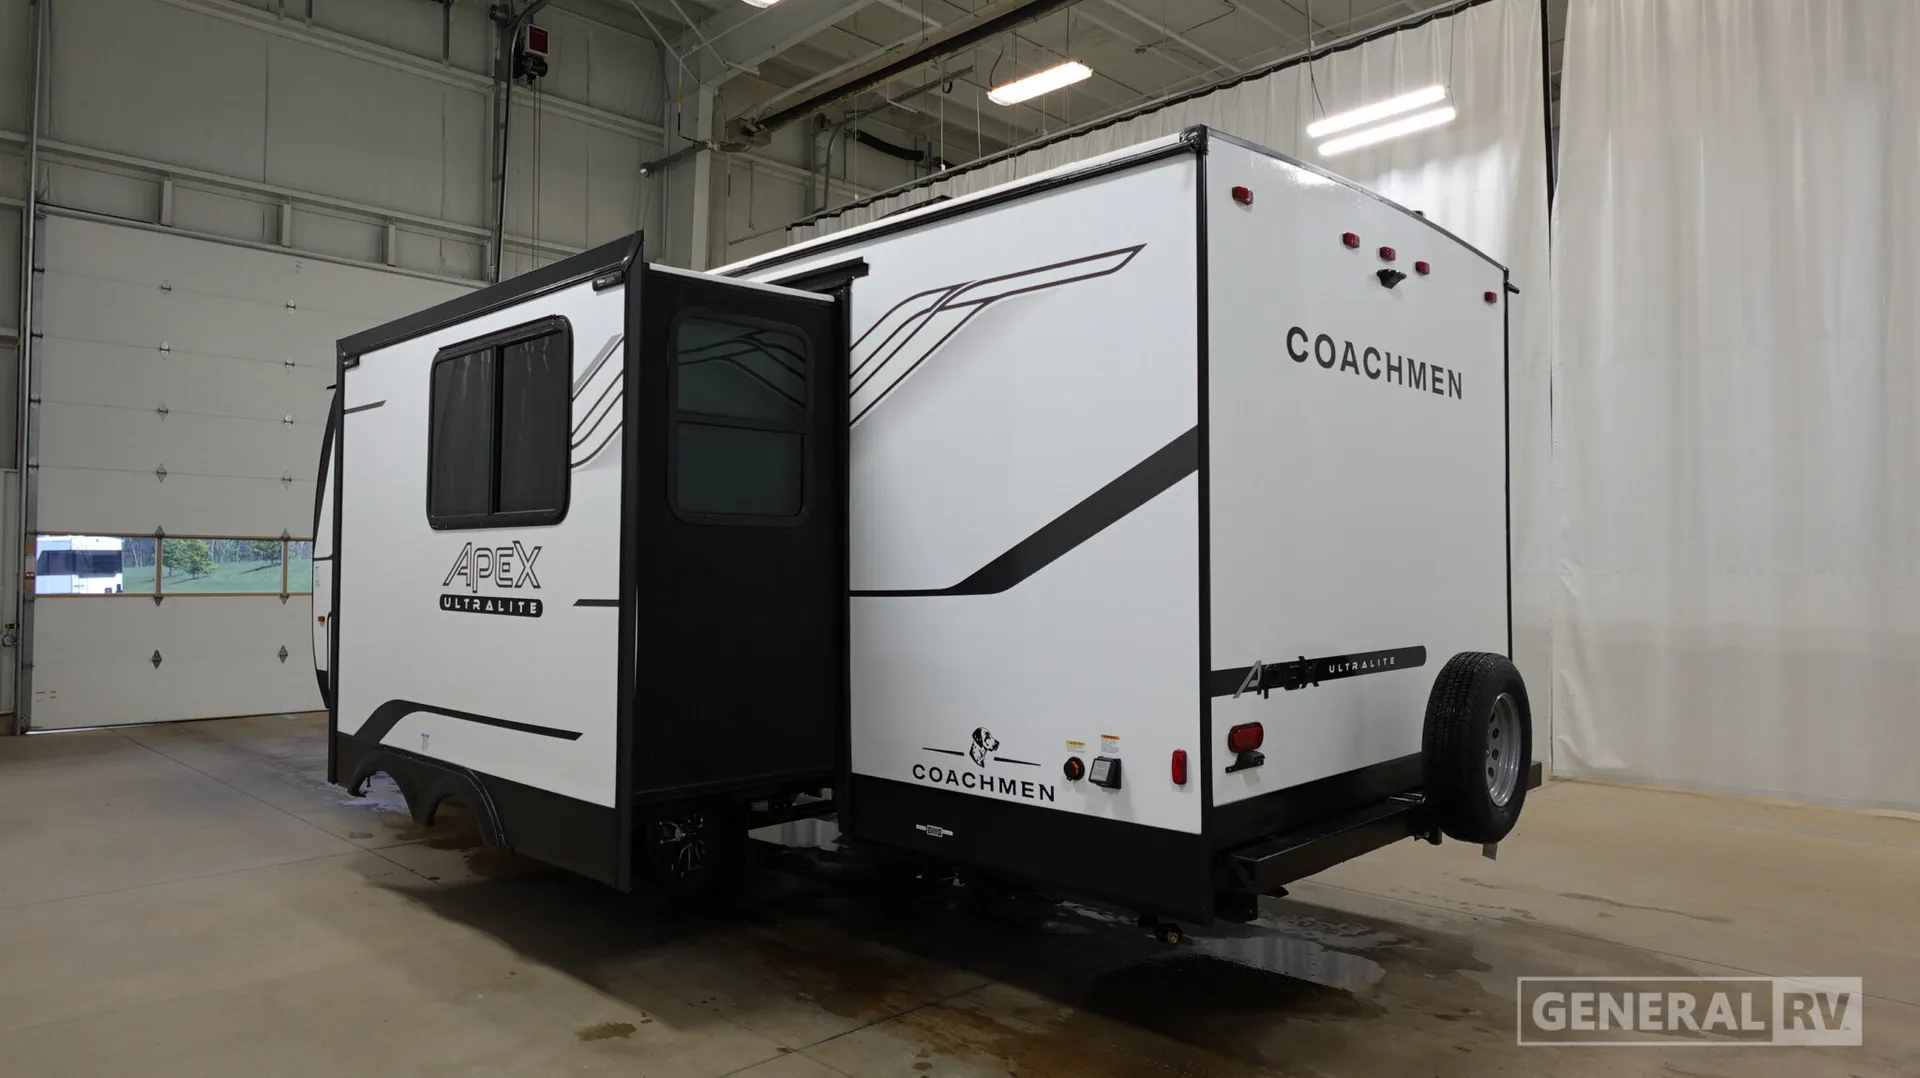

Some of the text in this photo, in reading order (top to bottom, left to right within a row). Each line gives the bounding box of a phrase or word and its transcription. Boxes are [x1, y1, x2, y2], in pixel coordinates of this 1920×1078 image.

[1286, 326, 1462, 400] COACHMEN
[442, 540, 542, 593] APEX
[443, 597, 538, 614] ULTRALITE
[1328, 656, 1396, 674] ULTRALITE
[912, 764, 1055, 802] COACHMEN
